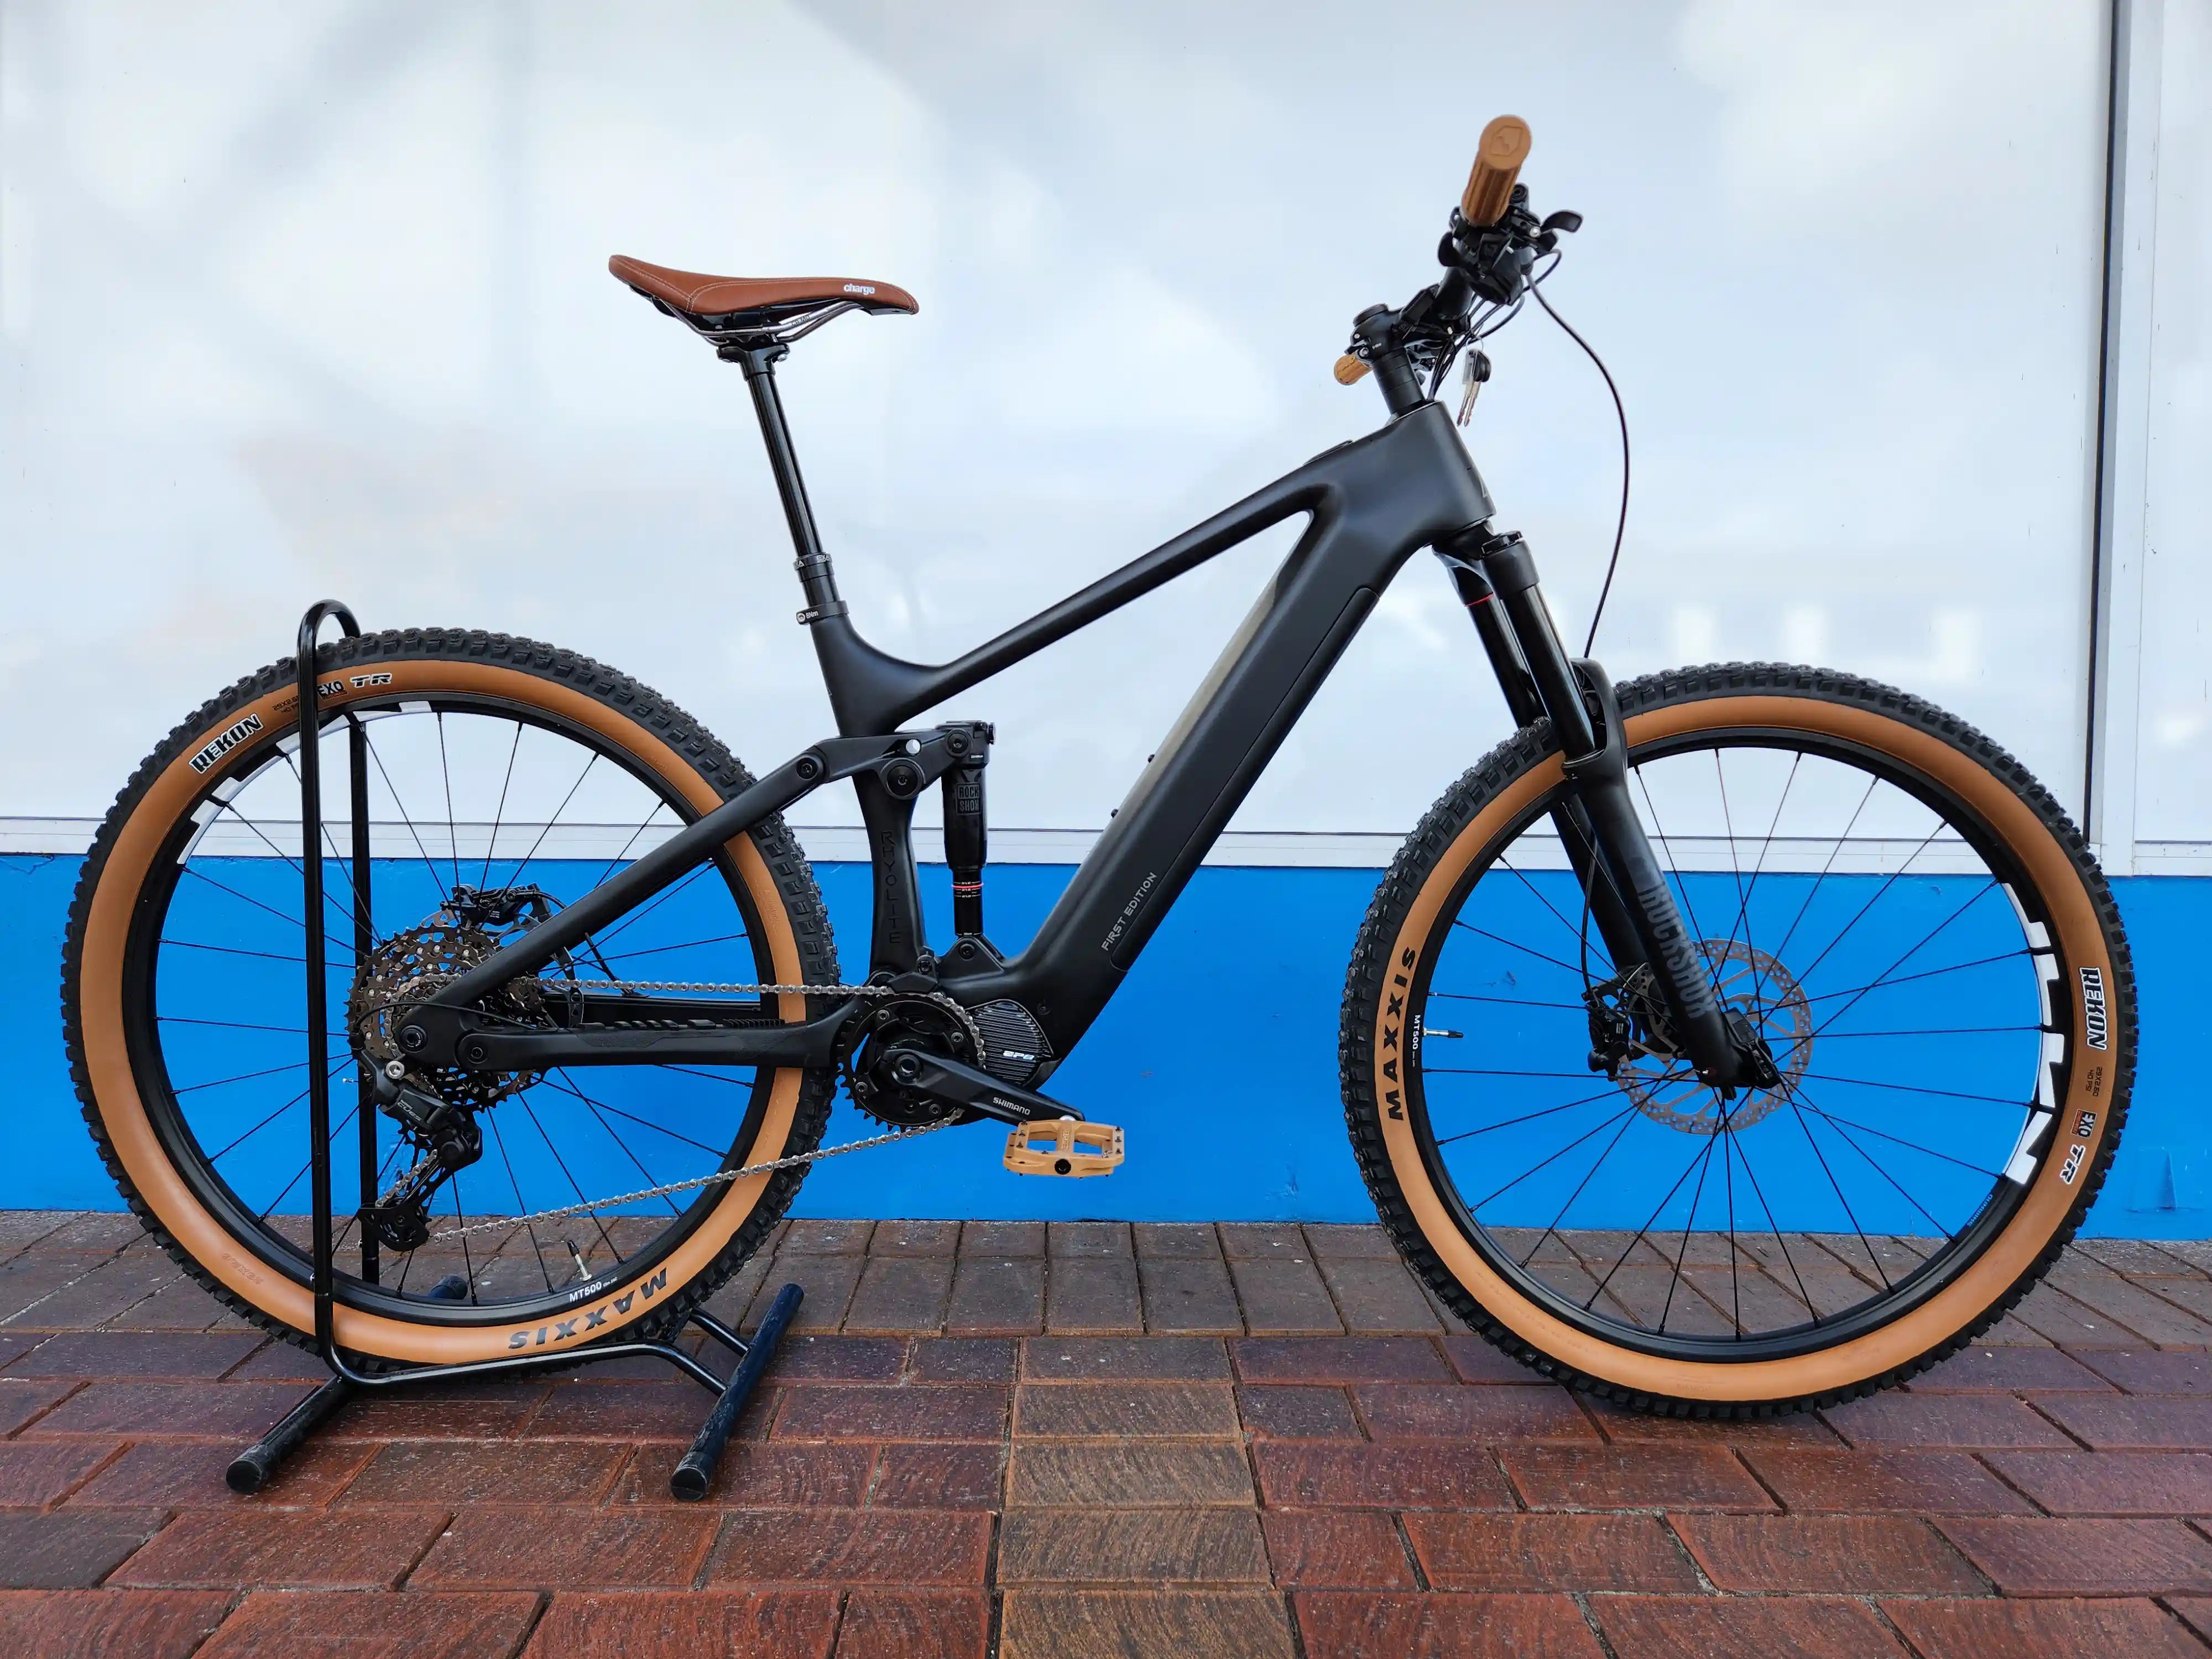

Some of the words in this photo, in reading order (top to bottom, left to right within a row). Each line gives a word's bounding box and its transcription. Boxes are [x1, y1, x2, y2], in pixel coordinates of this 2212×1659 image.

[843, 283, 875, 295] charge
[317, 681, 345, 695] EXO
[350, 672, 392, 688] TR
[188, 712, 264, 774] REKON
[881, 831, 902, 943] RHYOLITE
[1101, 916, 1126, 951] FIRST
[1124, 872, 1157, 916] EDITION
[2079, 967, 2107, 1050] REKON
[1384, 946, 1416, 1121] MAXXIS
[1412, 1015, 1421, 1050] MT500
[993, 1097, 1031, 1115] SHIMANO
[2078, 1112, 2095, 1138] EXO
[2060, 1144, 2086, 1185] TR
[1966, 1194, 1993, 1227] SHIMANO
[509, 1267, 667, 1349] MAXXIS
[569, 1281, 602, 1303] MT500
